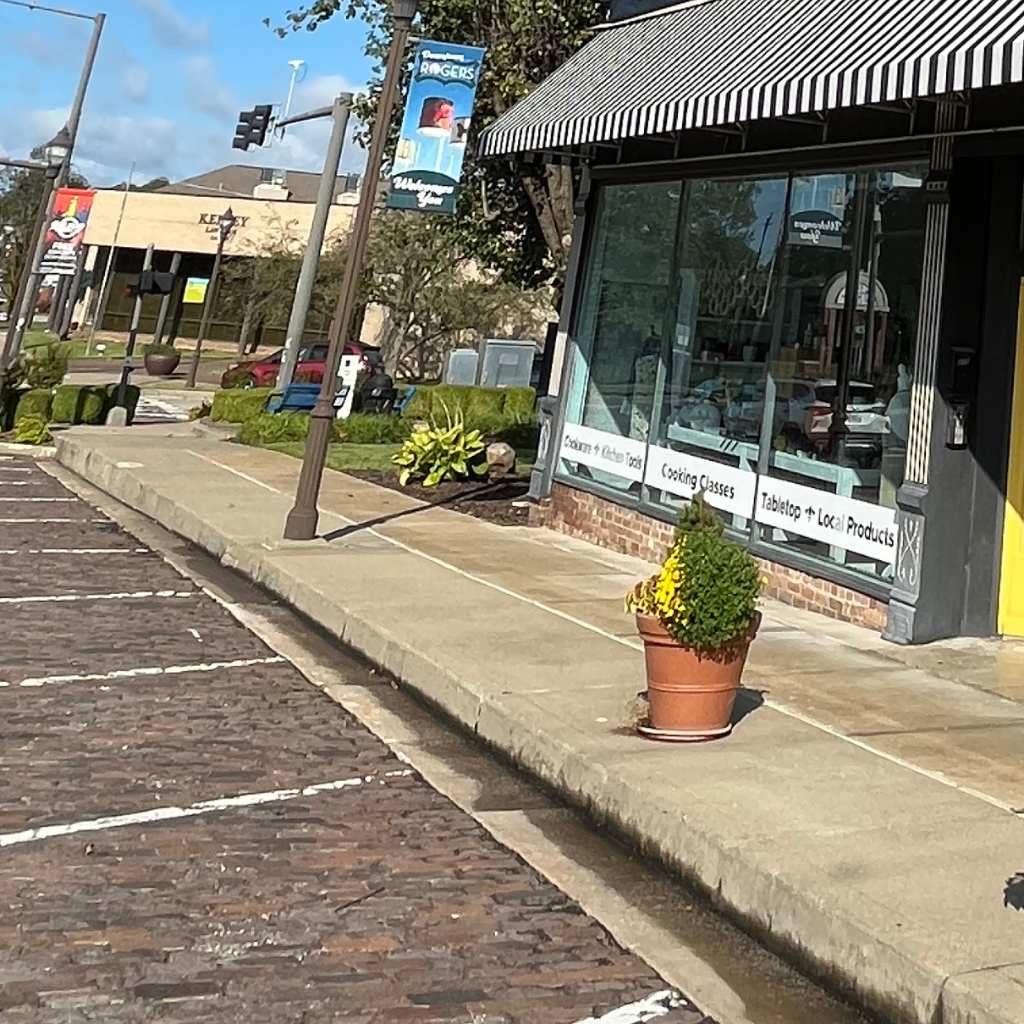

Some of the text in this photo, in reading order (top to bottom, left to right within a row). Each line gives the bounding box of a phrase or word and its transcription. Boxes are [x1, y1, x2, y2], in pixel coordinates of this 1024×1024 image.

[419, 61, 475, 80] ROGERS
[624, 451, 643, 470] Tools
[661, 462, 736, 499] Cooking Classes
[761, 492, 896, 548] Tabletop Local Products
